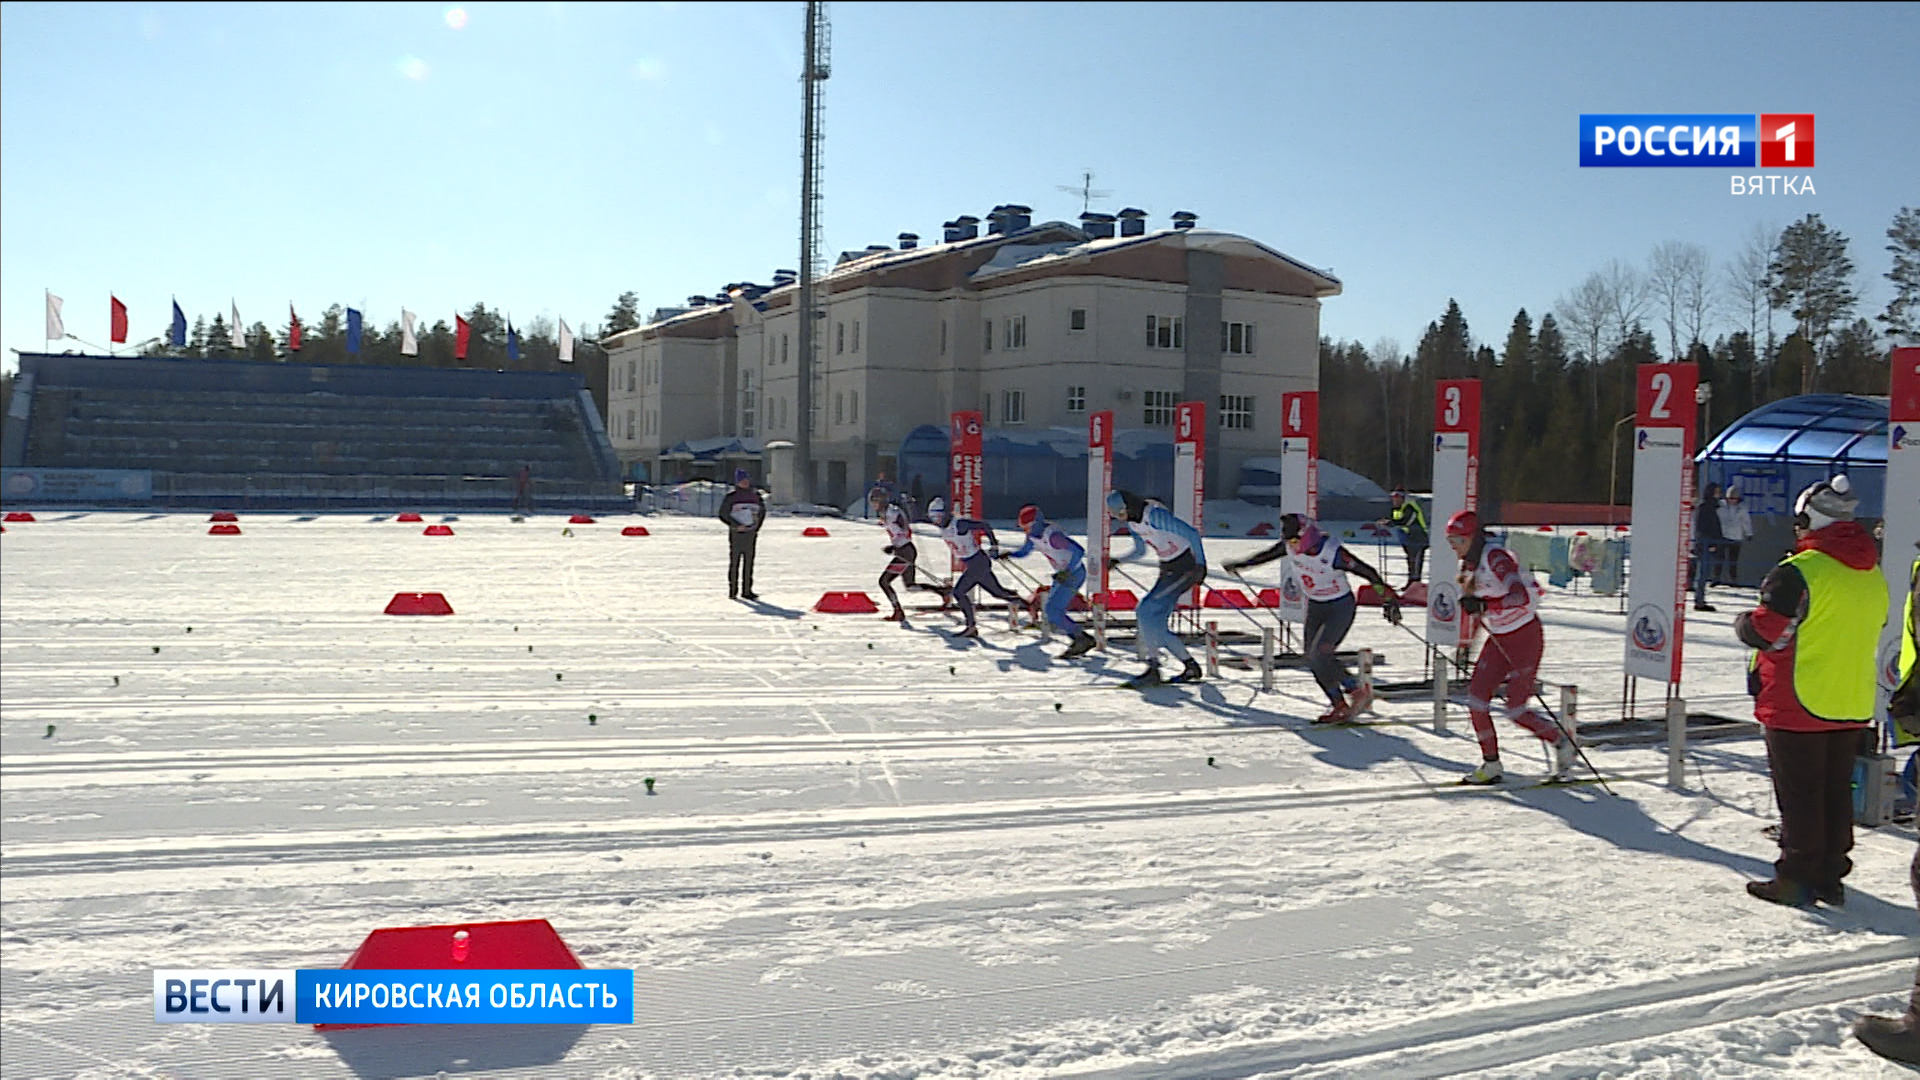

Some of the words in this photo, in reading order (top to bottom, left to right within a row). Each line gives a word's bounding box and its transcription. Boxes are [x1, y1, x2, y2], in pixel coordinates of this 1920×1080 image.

[1444, 387, 1460, 426] 3
[1650, 373, 1672, 418] 2
[1092, 417, 1102, 443] 6
[1180, 407, 1191, 437] 5
[1288, 397, 1301, 432] 4
